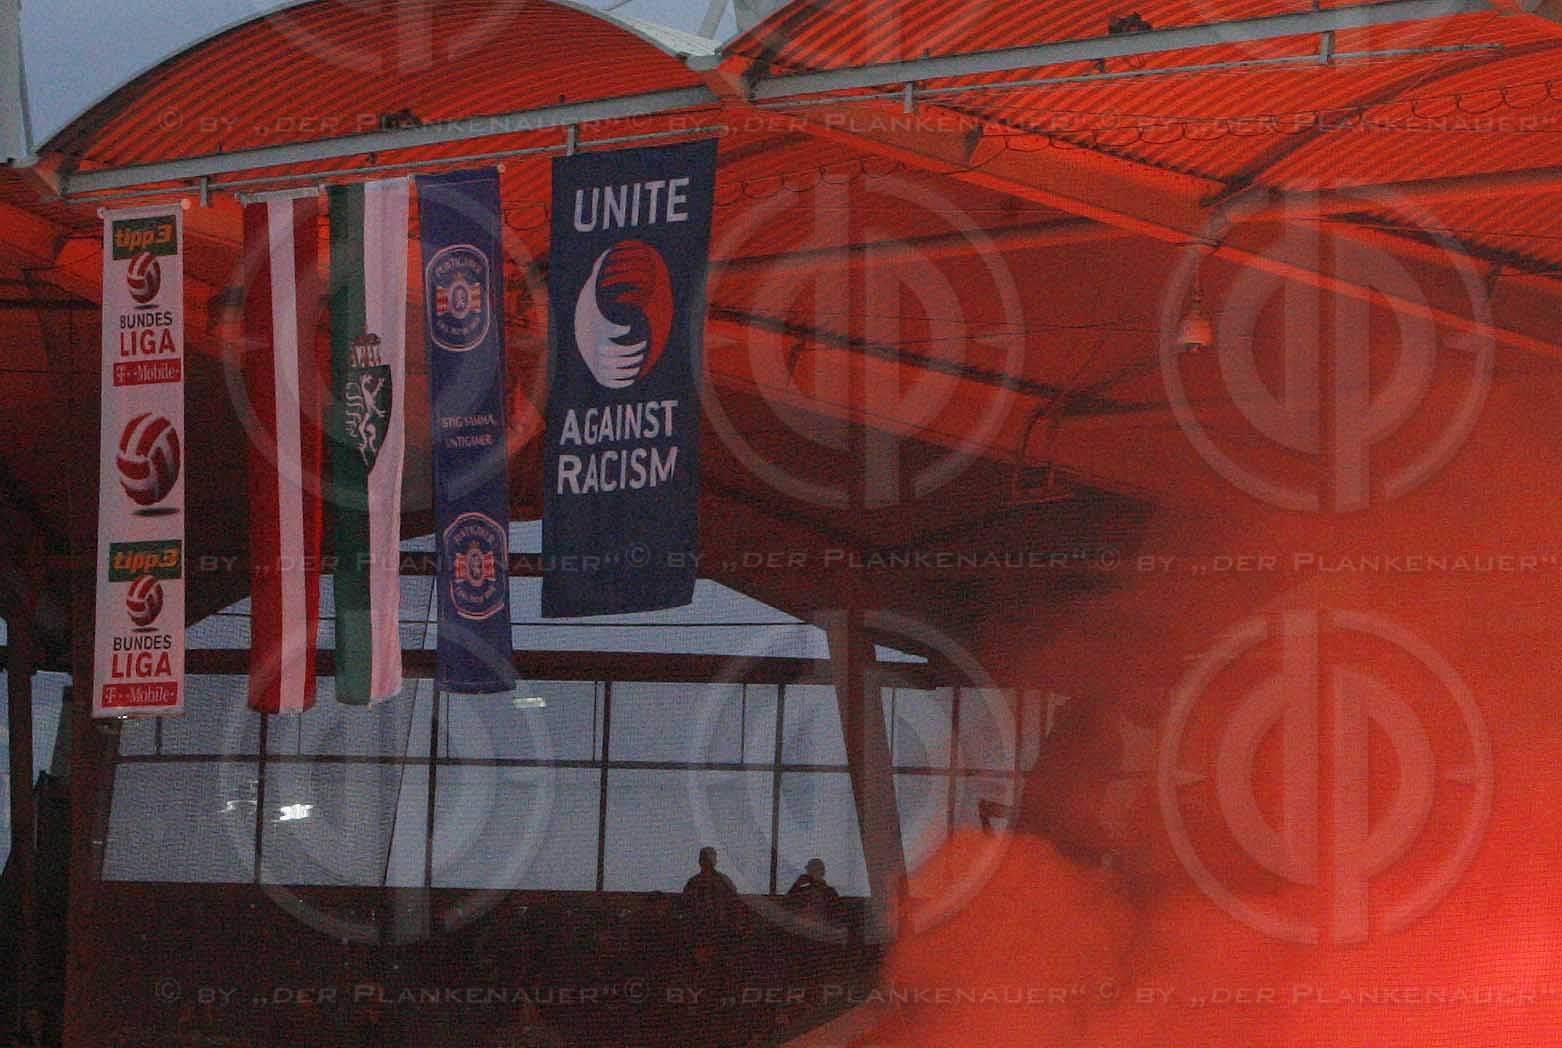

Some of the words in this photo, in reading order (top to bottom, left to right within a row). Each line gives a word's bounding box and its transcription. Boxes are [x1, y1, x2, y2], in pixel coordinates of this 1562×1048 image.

[574, 177, 690, 233] UNITE
[120, 311, 173, 329] BUNDES
[120, 328, 176, 358] LIGA
[560, 400, 679, 446] AGAINST
[557, 446, 678, 495] RACISM
[113, 635, 172, 651] BUNDES
[111, 651, 172, 679] LIGA
